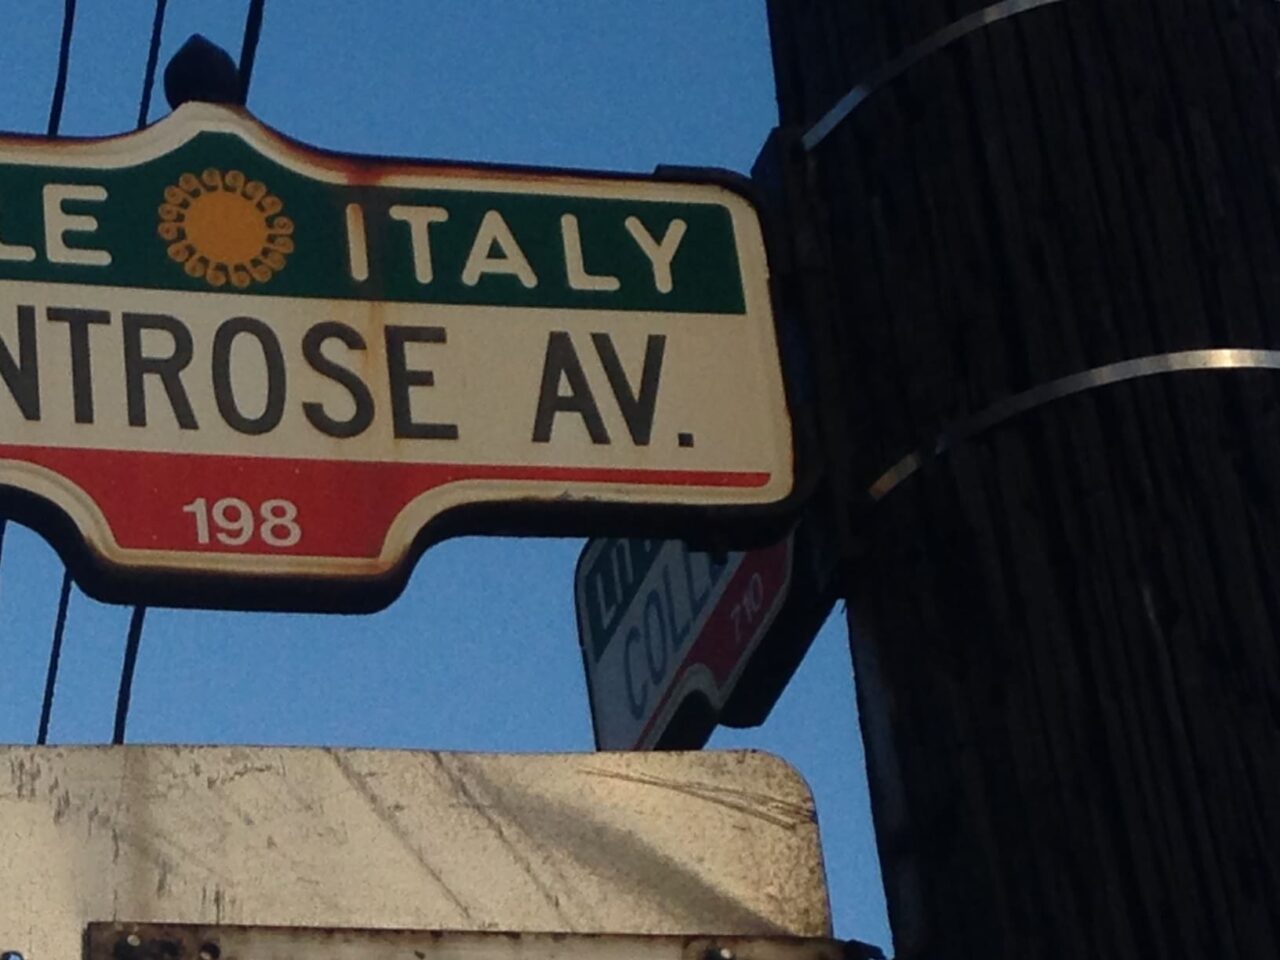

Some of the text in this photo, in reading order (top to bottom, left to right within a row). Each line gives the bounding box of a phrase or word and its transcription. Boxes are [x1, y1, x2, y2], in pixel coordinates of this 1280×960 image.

[346, 202, 687, 293] ITALY
[531, 330, 694, 448] AV.
[183, 497, 301, 547] 198
